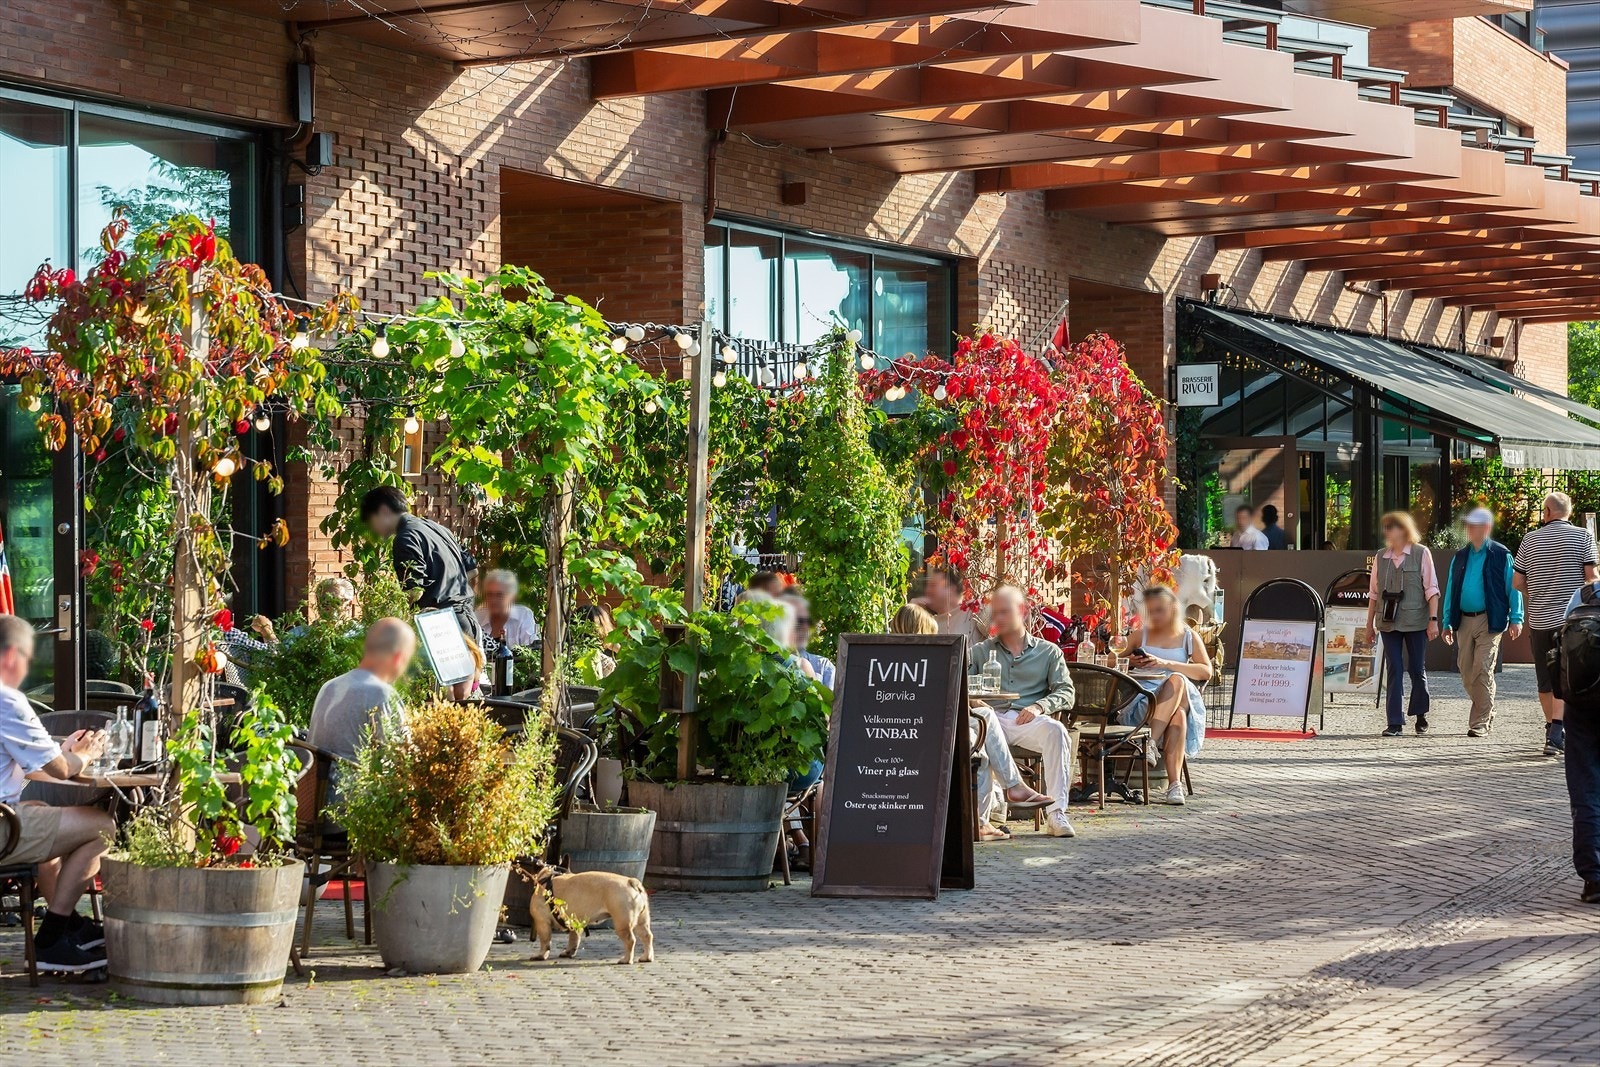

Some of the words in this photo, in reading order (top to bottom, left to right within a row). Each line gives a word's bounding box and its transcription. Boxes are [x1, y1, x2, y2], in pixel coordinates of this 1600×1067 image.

[1182, 383, 1213, 394] RIVOLI
[868, 658, 928, 687] [VIN]
[1251, 678, 1257, 686] 2
[1257, 678, 1269, 686] for
[876, 690, 916, 703] Bjørvika
[863, 715, 911, 724] Velkommen
[913, 716, 924, 726] på
[865, 728, 918, 739] VINBAR
[857, 766, 883, 775] Viner
[885, 767, 897, 777] på
[898, 767, 919, 777] glass
[861, 792, 896, 800] Snacksmeny
[844, 800, 866, 809] Oster
[878, 801, 907, 810] skinker
